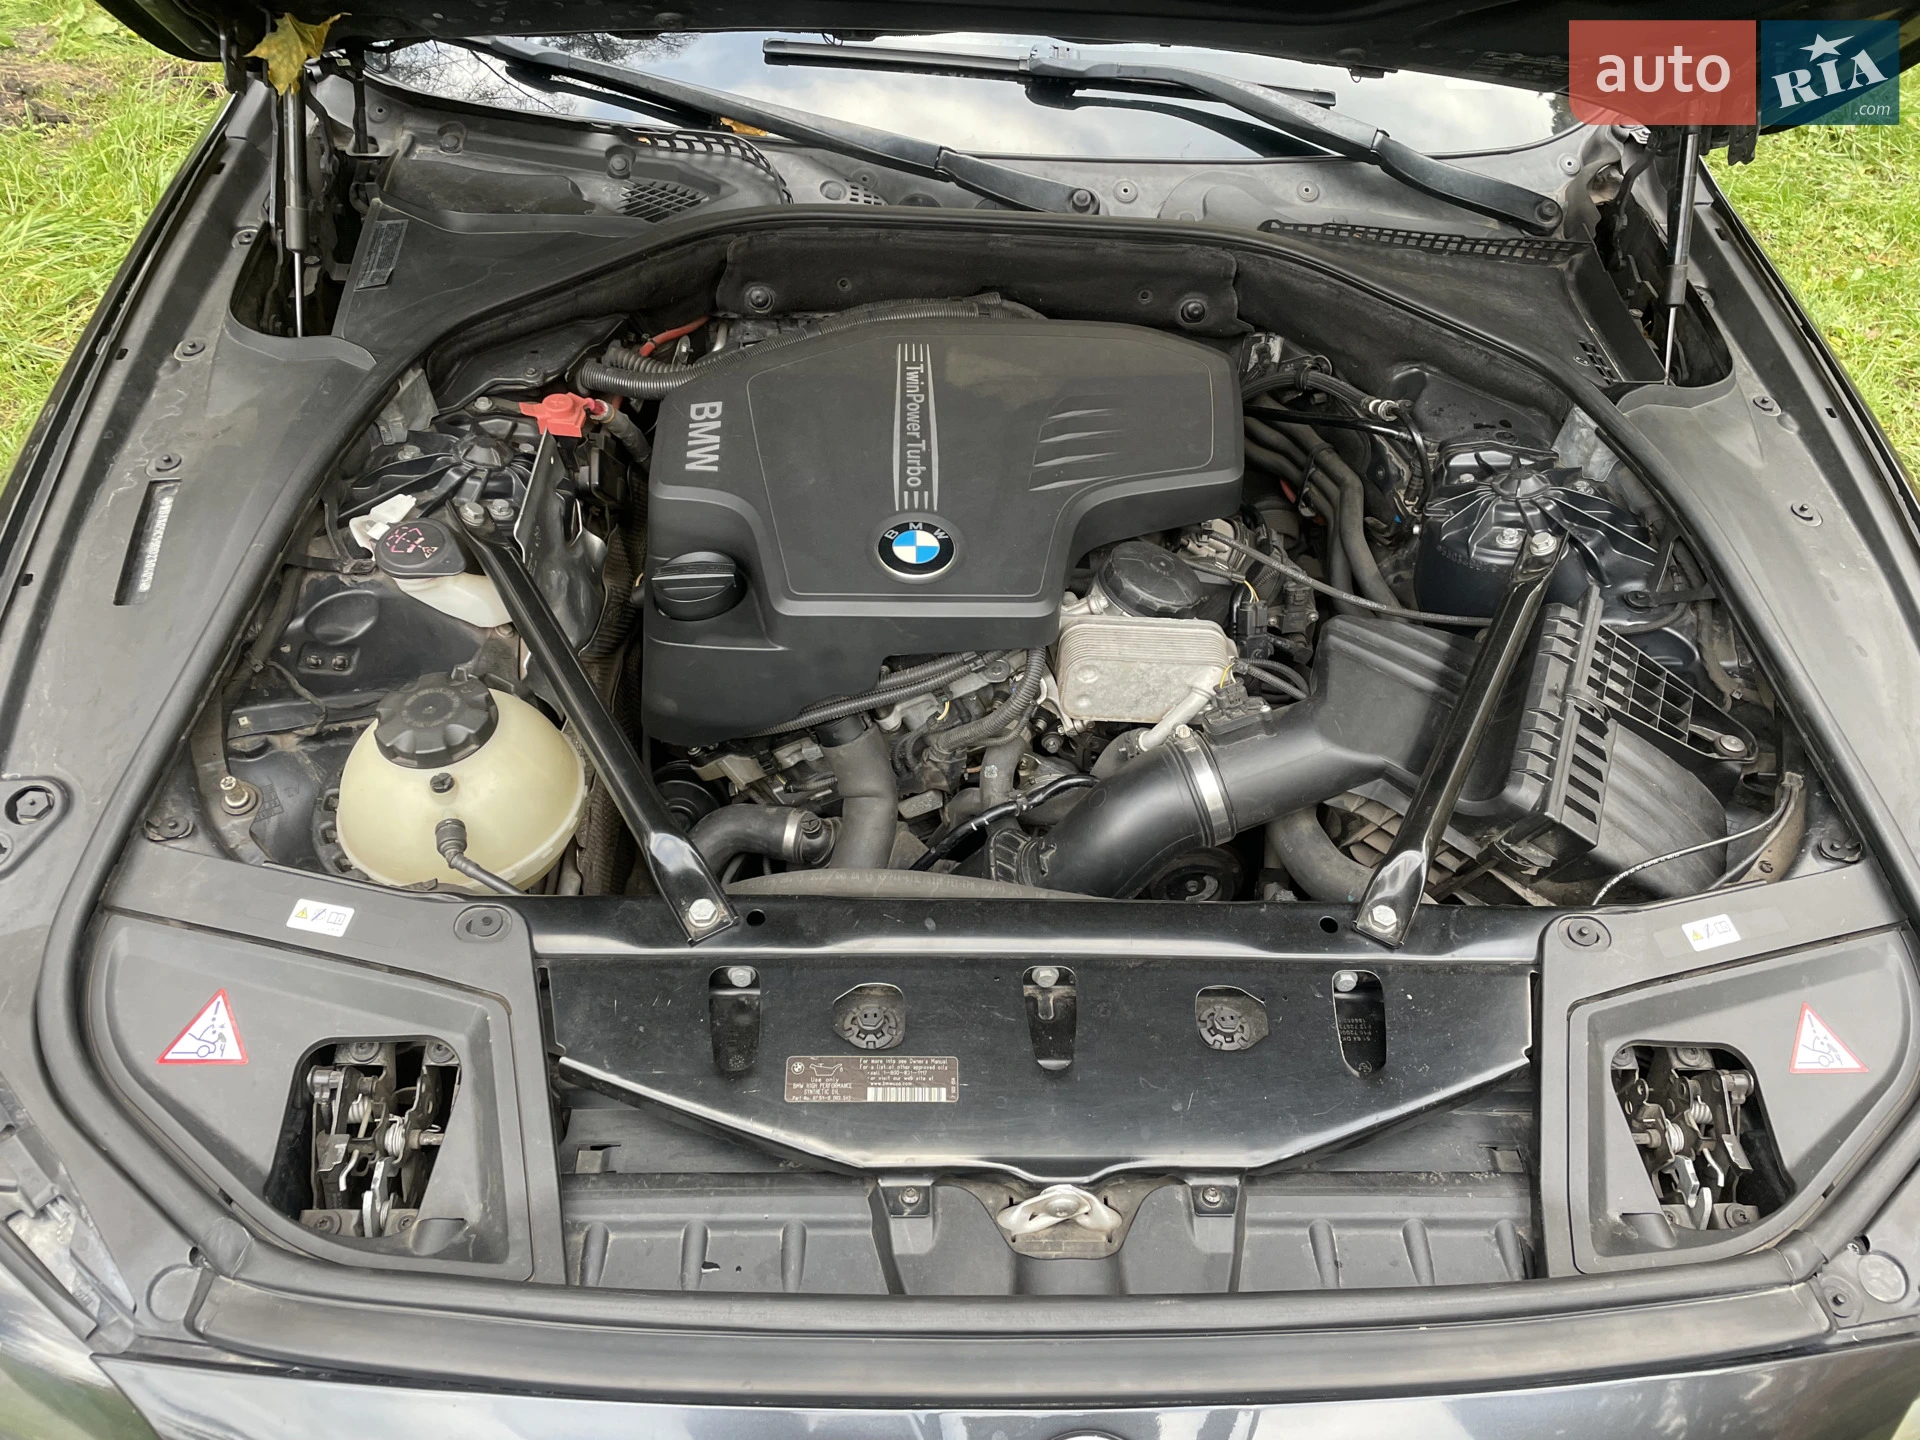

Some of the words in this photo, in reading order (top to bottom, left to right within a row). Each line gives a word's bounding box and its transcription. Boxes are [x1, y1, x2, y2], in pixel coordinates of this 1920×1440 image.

[906, 363, 925, 439] TwinPower
[685, 401, 723, 472] BMW
[906, 439, 927, 488] Turbo
[884, 521, 949, 540] BMW
